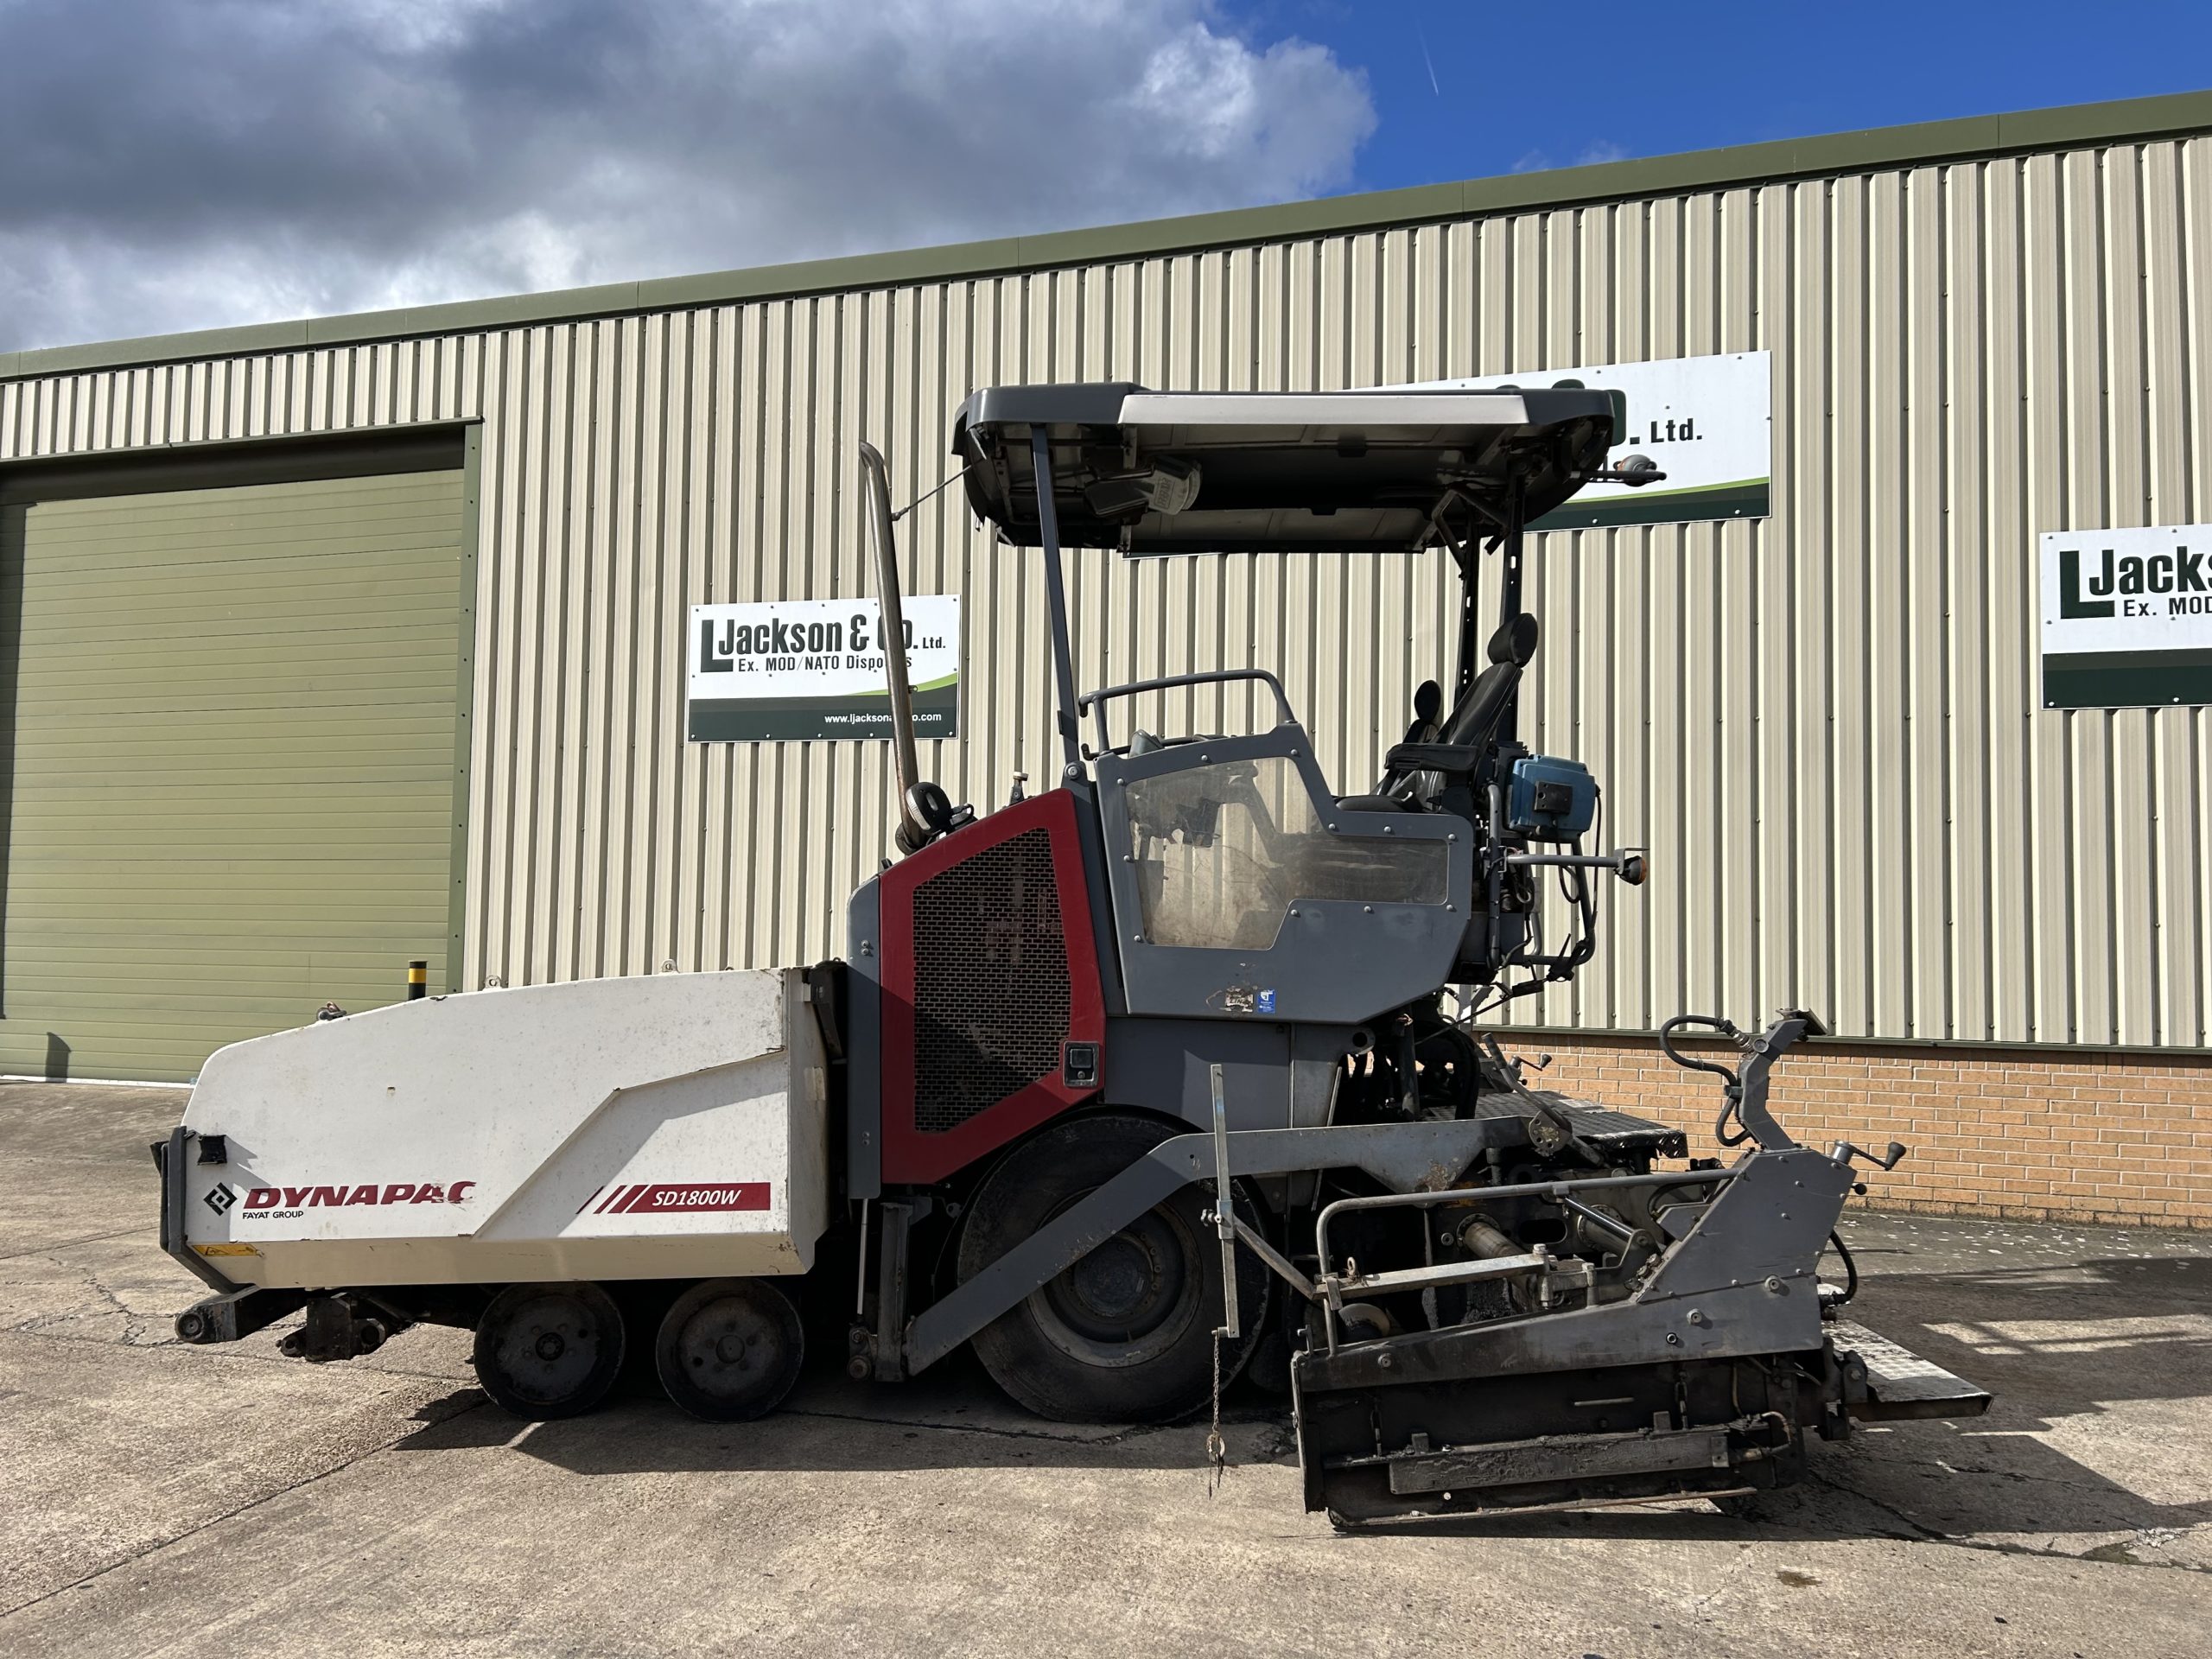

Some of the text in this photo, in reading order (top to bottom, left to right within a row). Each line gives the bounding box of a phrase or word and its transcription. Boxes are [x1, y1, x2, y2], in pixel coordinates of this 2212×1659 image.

[1650, 417, 1702, 443] Ltd.
[2059, 546, 2212, 620] LJack
[2123, 599, 2158, 617] Ex.
[849, 613, 870, 652] &
[922, 636, 946, 649] Ltd.
[738, 658, 759, 672] Ex.
[846, 655, 912, 671] Dispos
[824, 713, 942, 724] www.ljacksono.com
[243, 1181, 477, 1209] DYNAPAC
[652, 1190, 741, 1206] SD1800W
[242, 1210, 304, 1220] FAYAT GROUP
